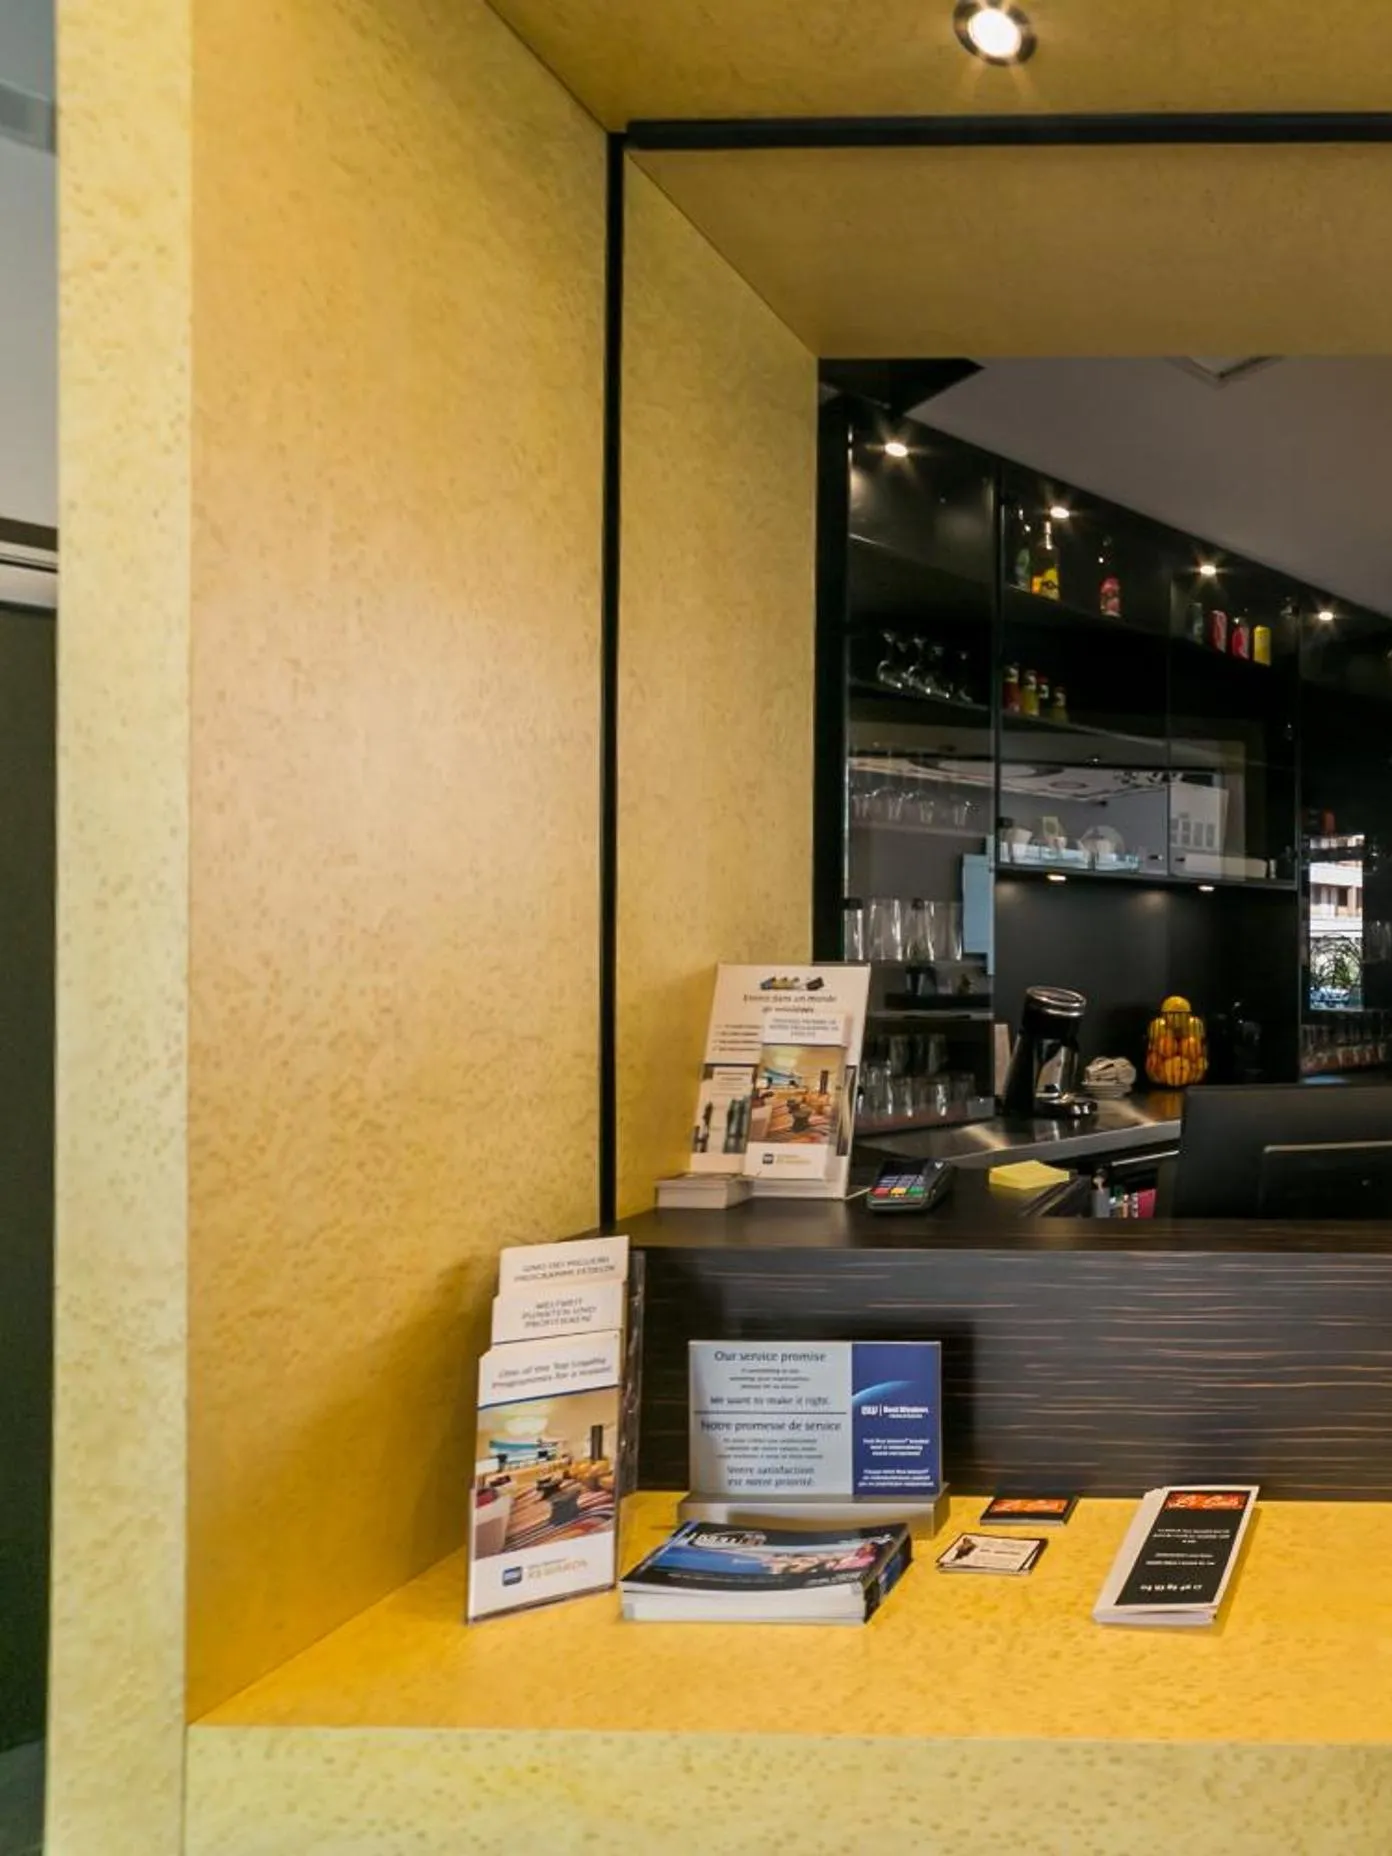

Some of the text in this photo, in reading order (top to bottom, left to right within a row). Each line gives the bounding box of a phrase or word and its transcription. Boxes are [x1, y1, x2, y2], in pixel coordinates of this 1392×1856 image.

[714, 1351, 827, 1364] Our service promise
[701, 1420, 731, 1432] Notre
[788, 1420, 801, 1431] de
[804, 1421, 842, 1432] service
[757, 1464, 815, 1475] satisfaction
